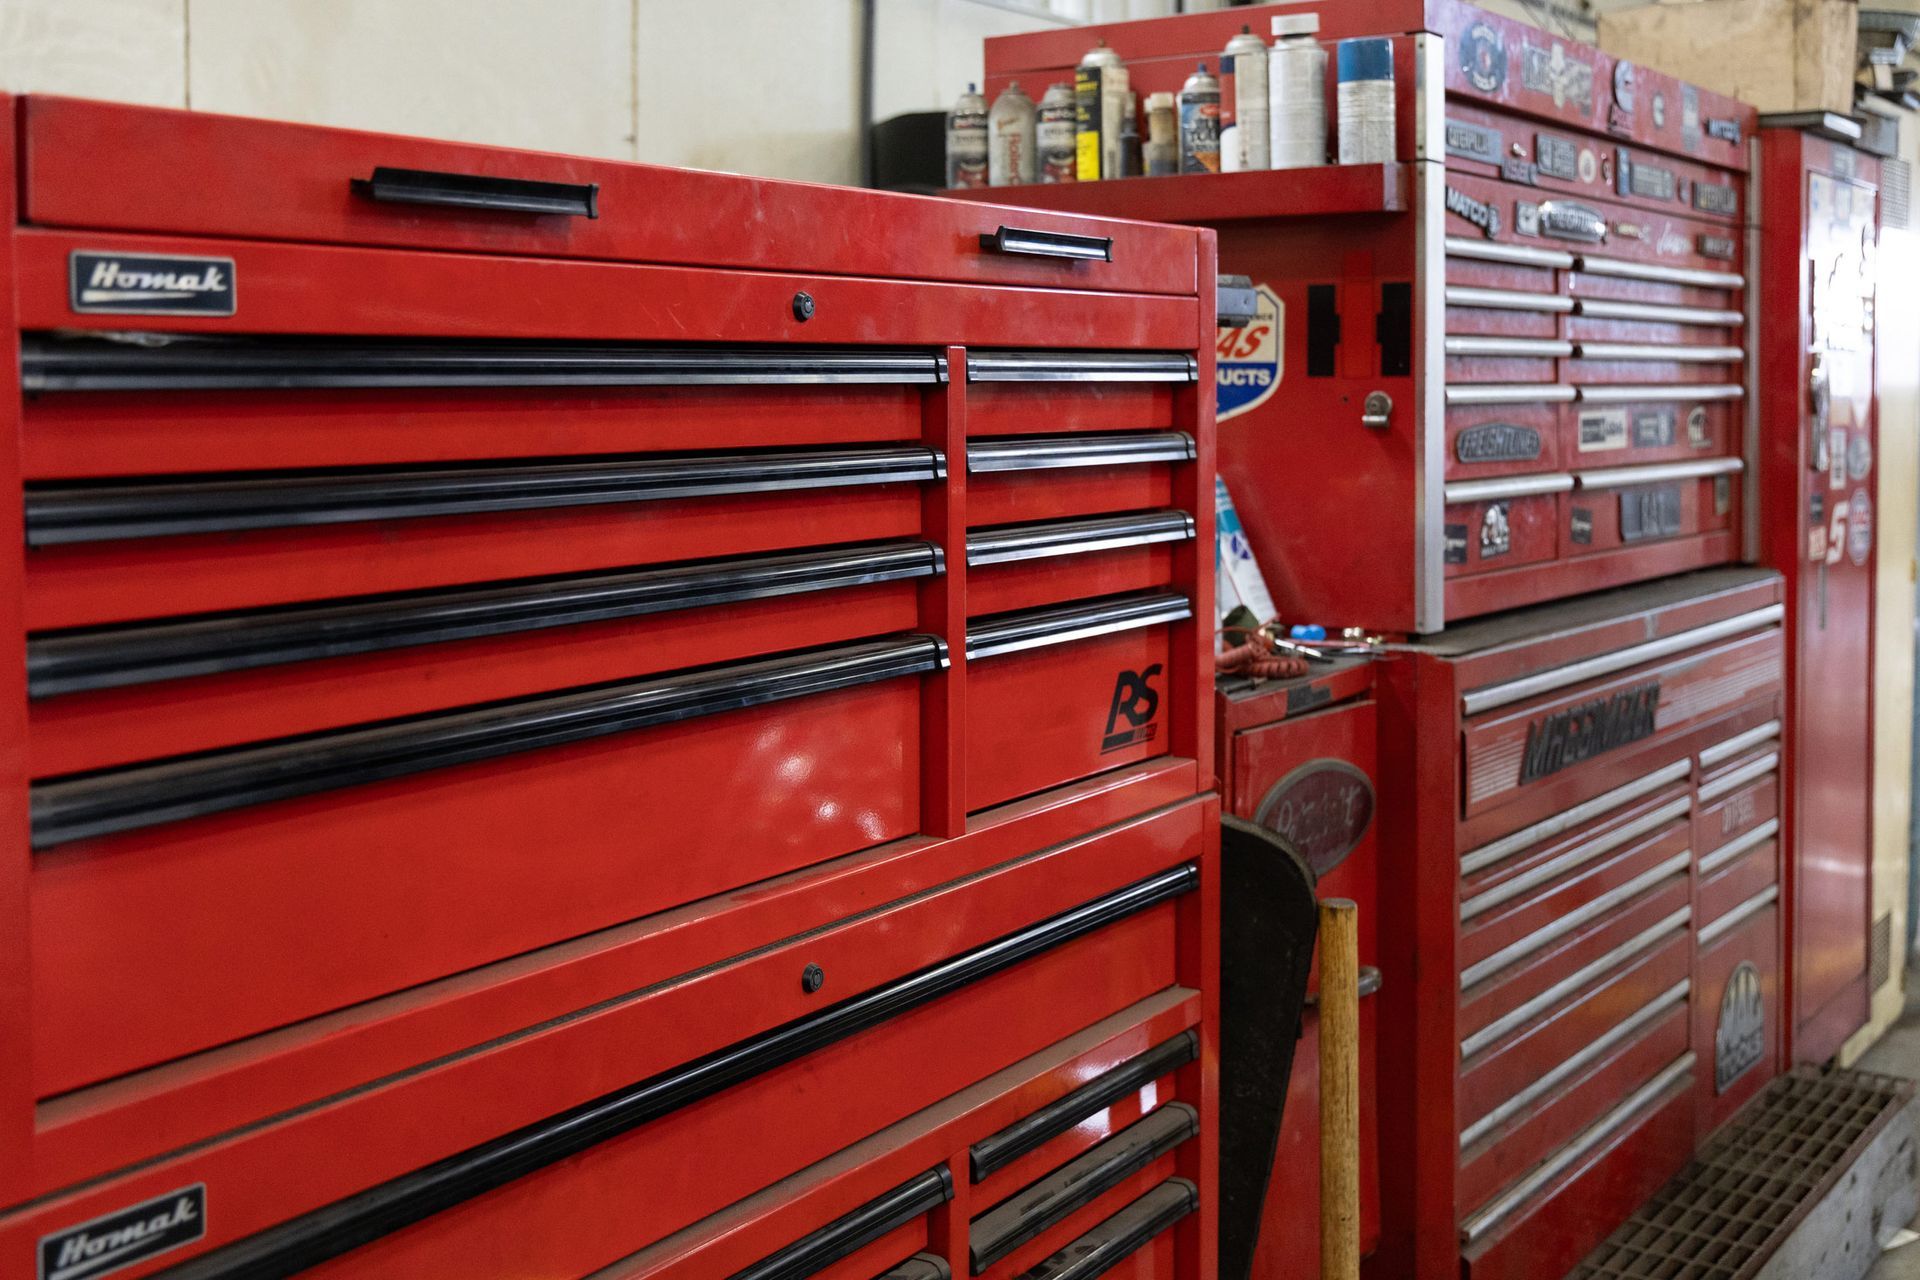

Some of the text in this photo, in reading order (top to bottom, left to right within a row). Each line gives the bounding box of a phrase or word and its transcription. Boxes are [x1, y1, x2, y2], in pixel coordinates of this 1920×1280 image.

[90, 261, 227, 292] Homak
[1216, 326, 1270, 359] AS
[1216, 367, 1271, 387] UCTS
[57, 1197, 197, 1269] Homak
